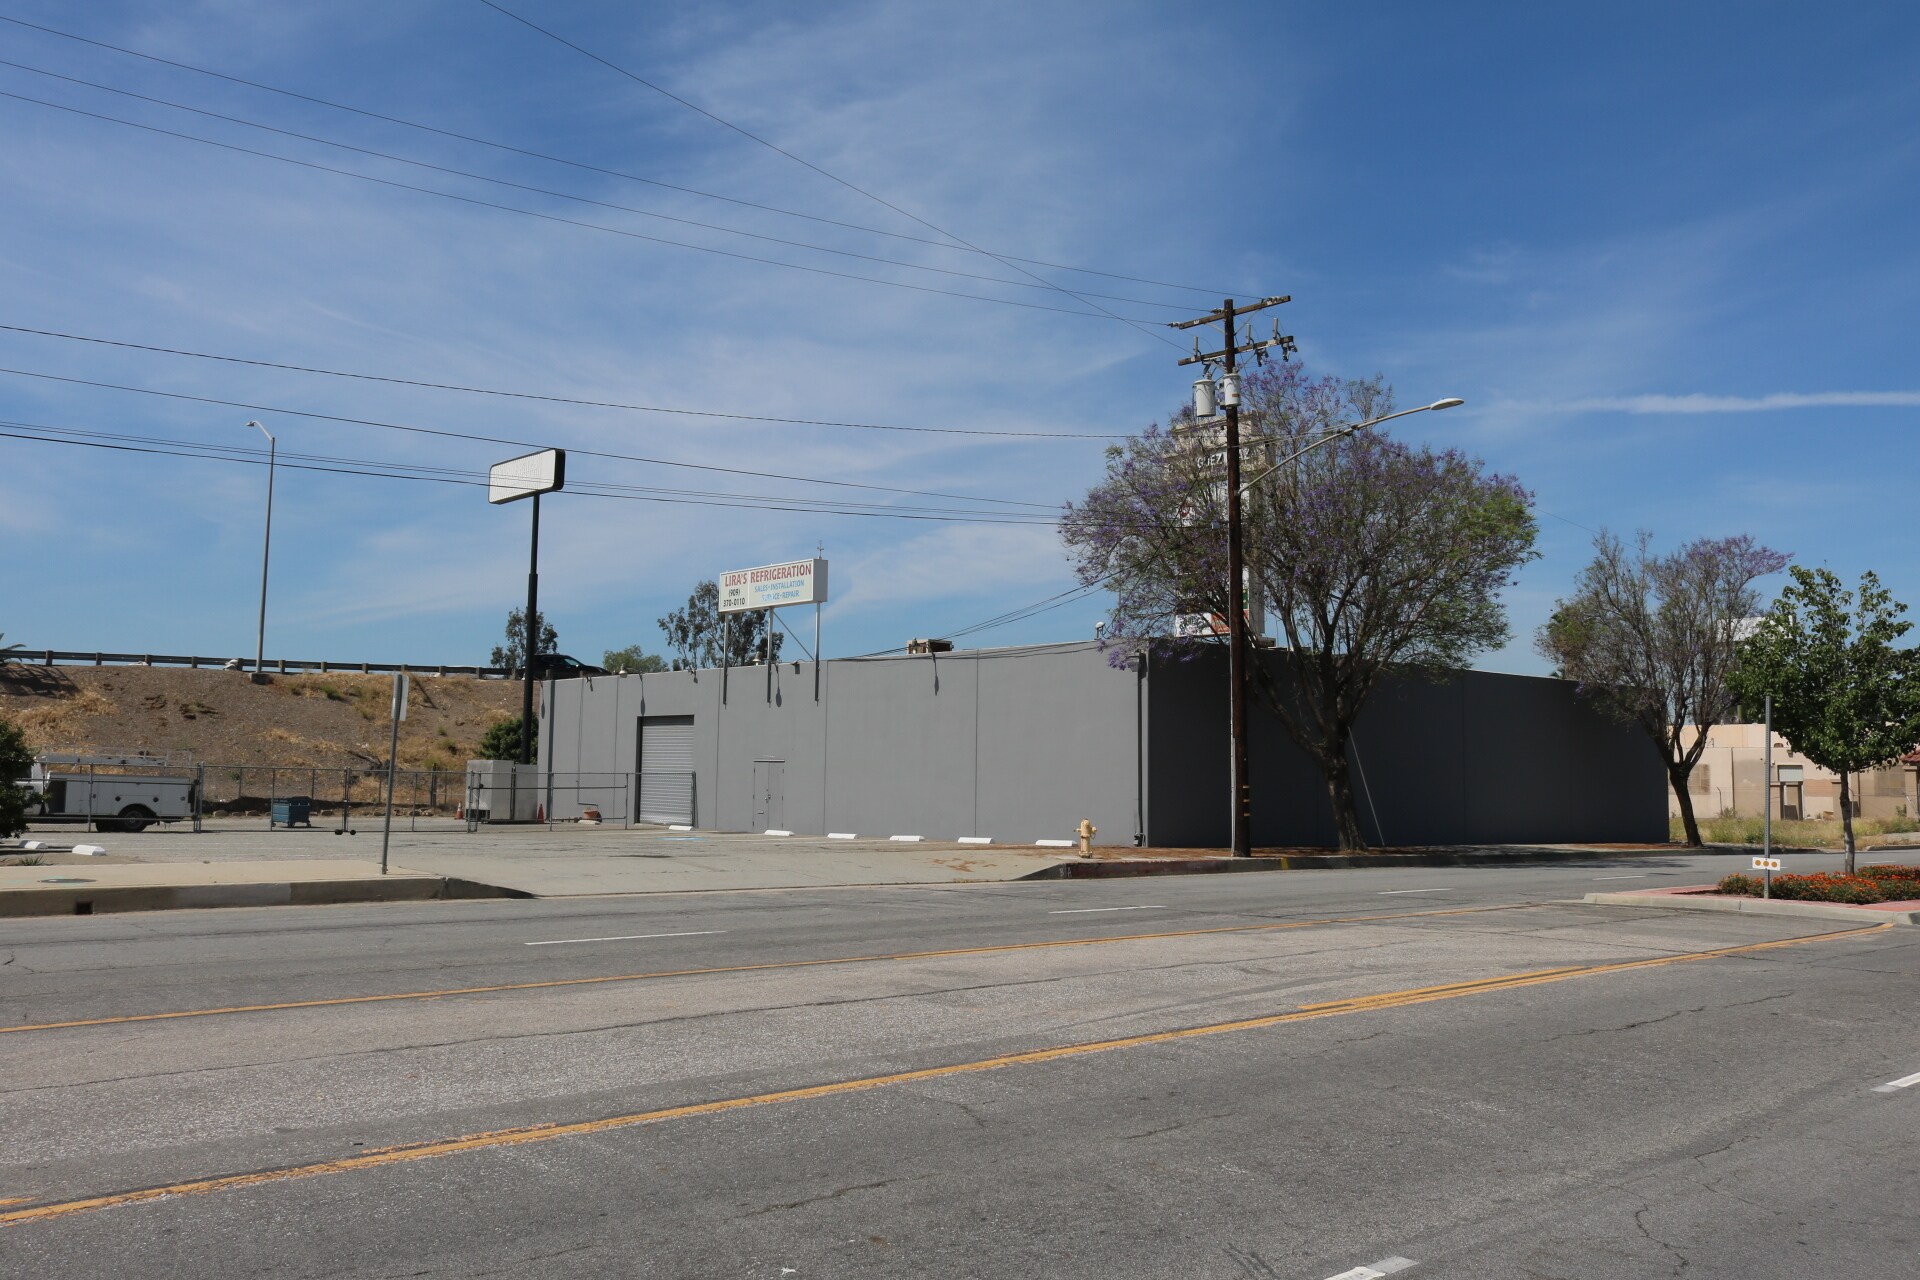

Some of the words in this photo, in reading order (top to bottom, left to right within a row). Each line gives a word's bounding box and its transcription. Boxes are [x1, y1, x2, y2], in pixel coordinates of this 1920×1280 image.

[725, 573, 747, 587] LIRA'S
[750, 563, 812, 583] REFRIGERATION
[729, 588, 740, 597] (909)
